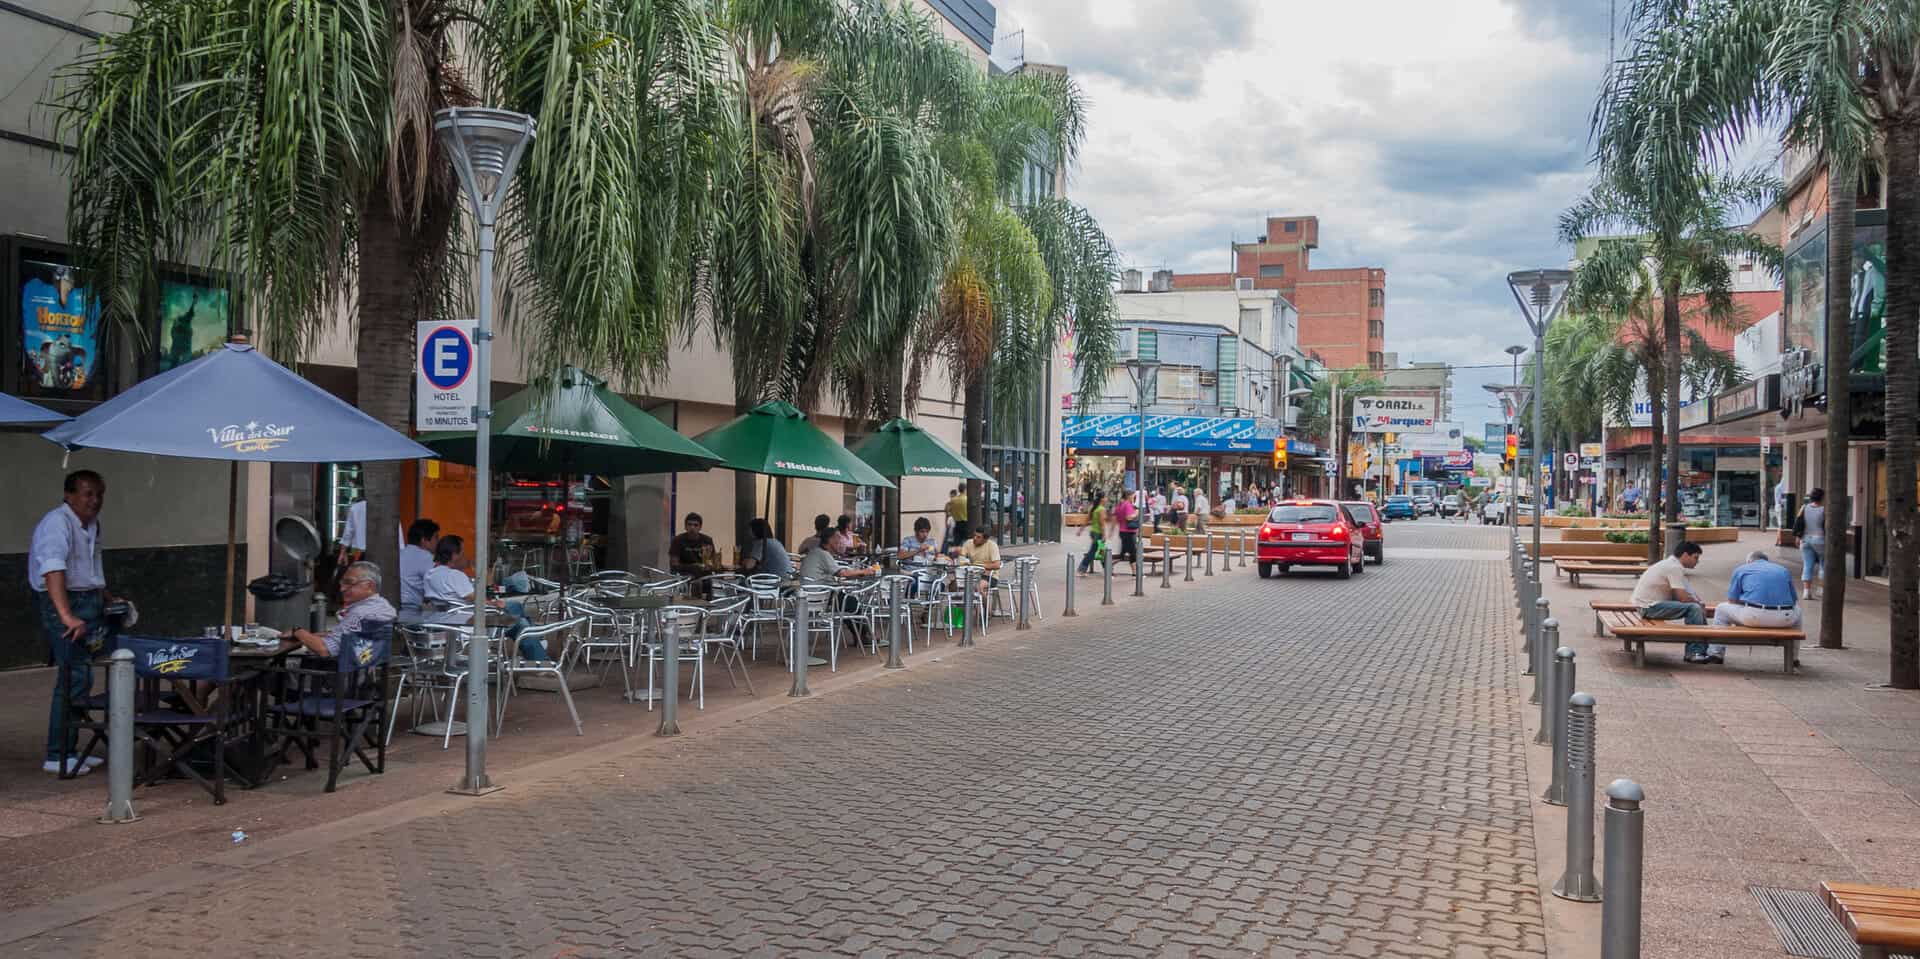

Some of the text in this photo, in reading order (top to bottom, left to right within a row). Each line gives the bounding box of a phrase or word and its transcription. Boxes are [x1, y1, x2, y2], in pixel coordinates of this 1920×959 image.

[433, 338, 460, 377] E
[433, 393, 462, 401] HOTEL
[425, 417, 468, 426] 10 MINUTOS
[206, 425, 244, 443] Villa
[263, 423, 295, 438] Sur
[542, 426, 619, 441] Heineken
[786, 462, 841, 476] Heineken
[919, 465, 964, 474] Heineken
[146, 650, 169, 666] Villa
